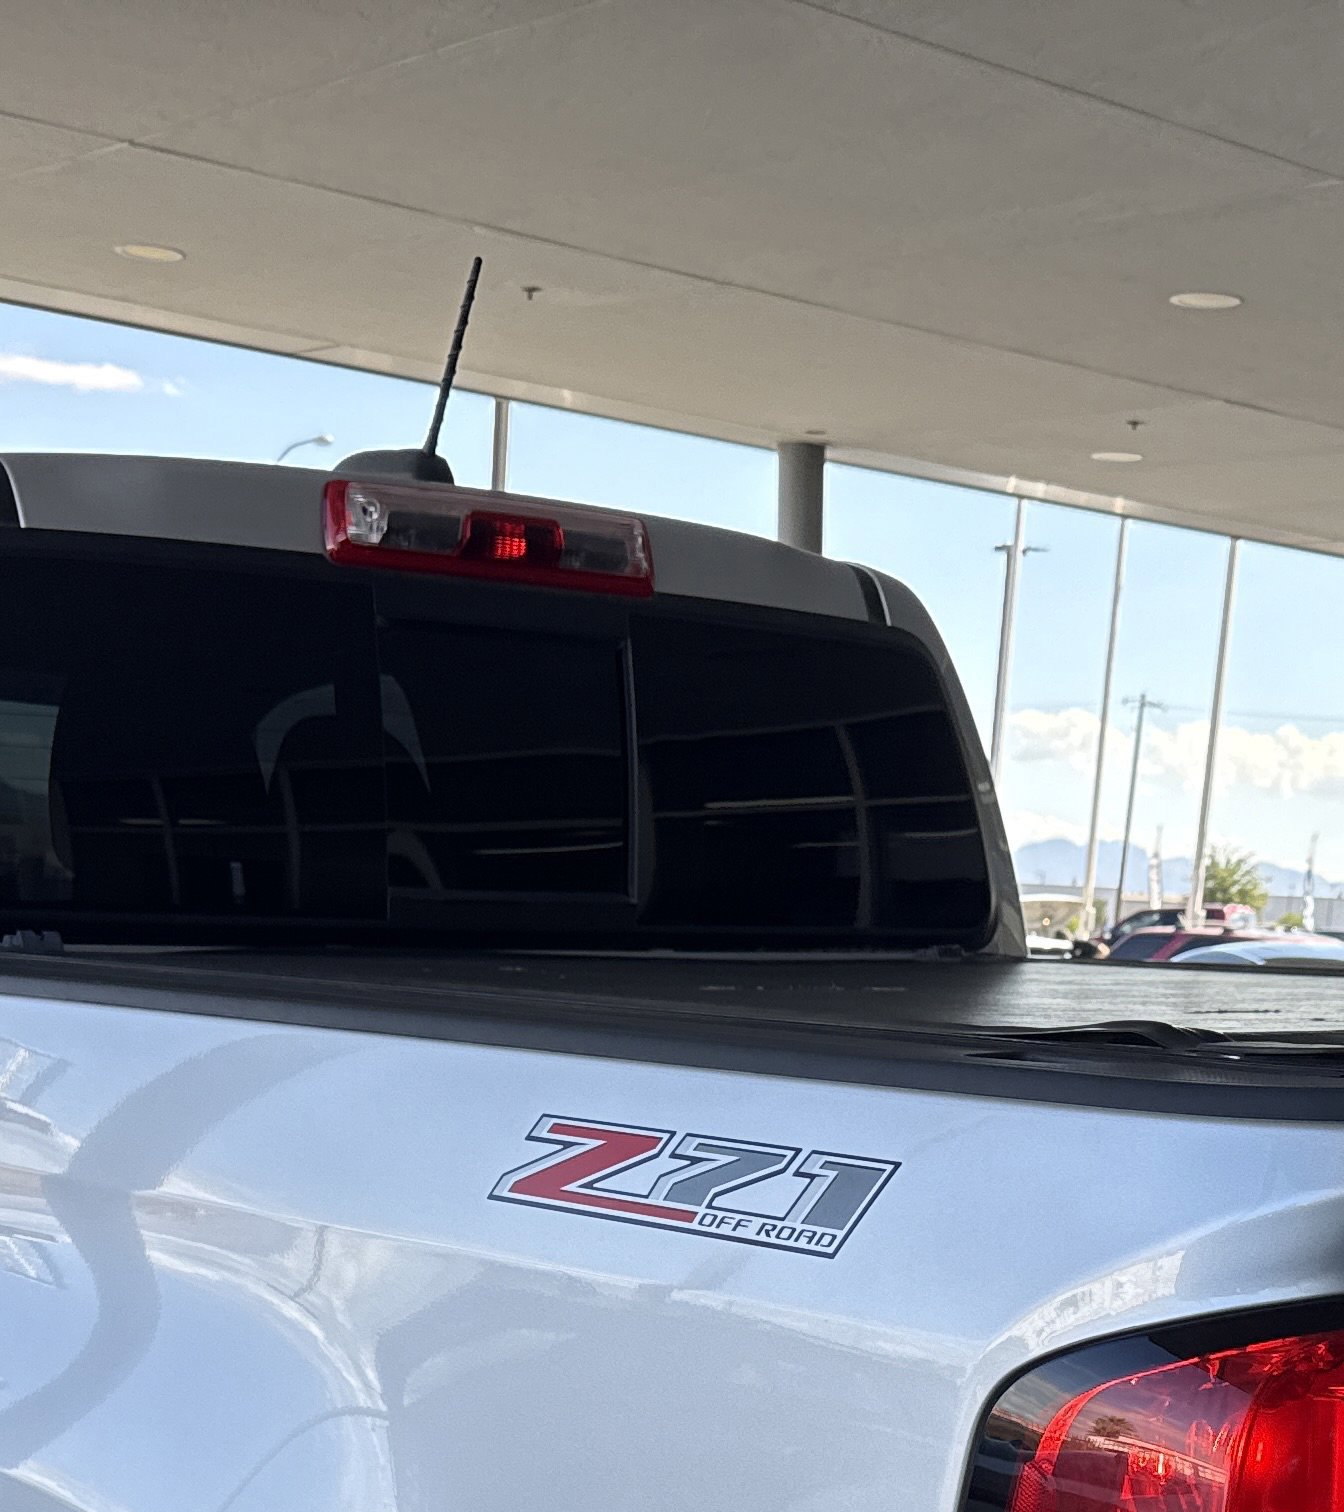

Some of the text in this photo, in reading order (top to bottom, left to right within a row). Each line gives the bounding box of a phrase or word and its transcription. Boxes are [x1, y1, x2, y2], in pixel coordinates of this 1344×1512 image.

[487, 1113, 903, 1260] Z71
[698, 1212, 838, 1249] OFF ROAD
